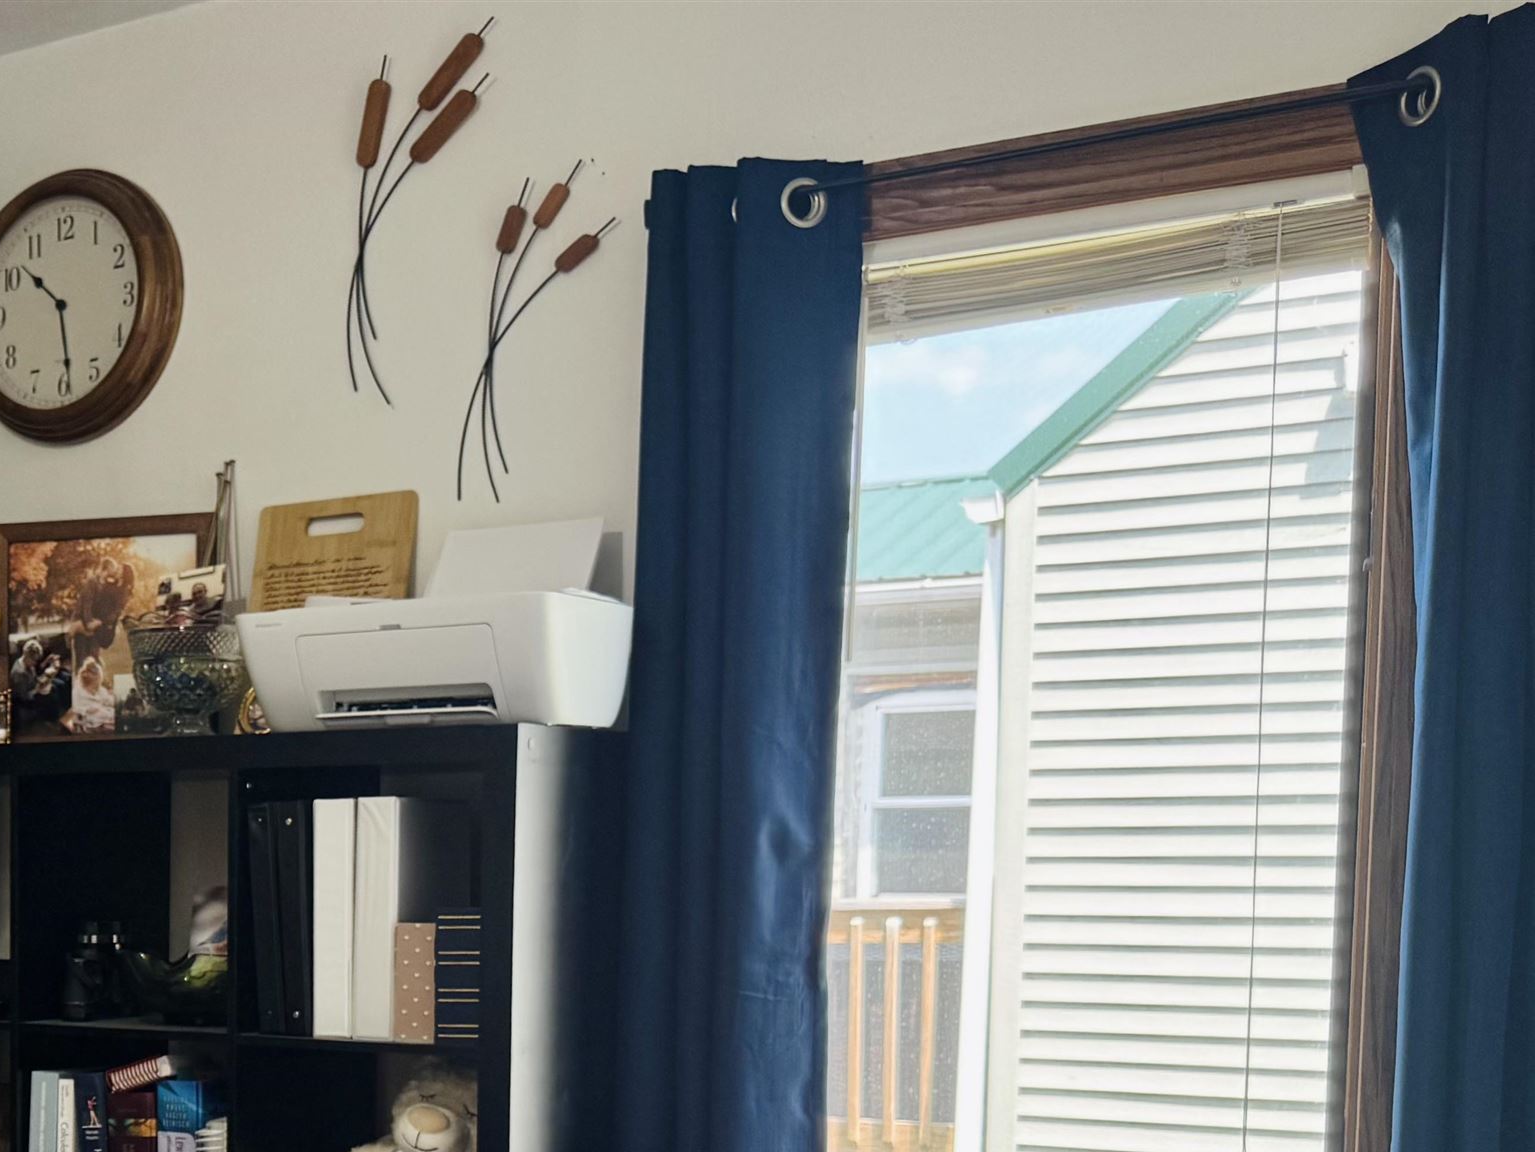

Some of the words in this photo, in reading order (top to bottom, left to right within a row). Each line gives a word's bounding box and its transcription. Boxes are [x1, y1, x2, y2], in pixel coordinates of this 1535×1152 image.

[56, 214, 76, 242] 12
[92, 219, 99, 245] 1
[27, 233, 42, 260] 11
[112, 243, 126, 270] 2
[3, 267, 21, 292] 10
[122, 281, 135, 307] 3
[114, 321, 125, 348] 4
[4, 345, 17, 369] 8
[88, 357, 100, 382] 5
[30, 369, 41, 394] 7
[56, 372, 70, 397] 6
